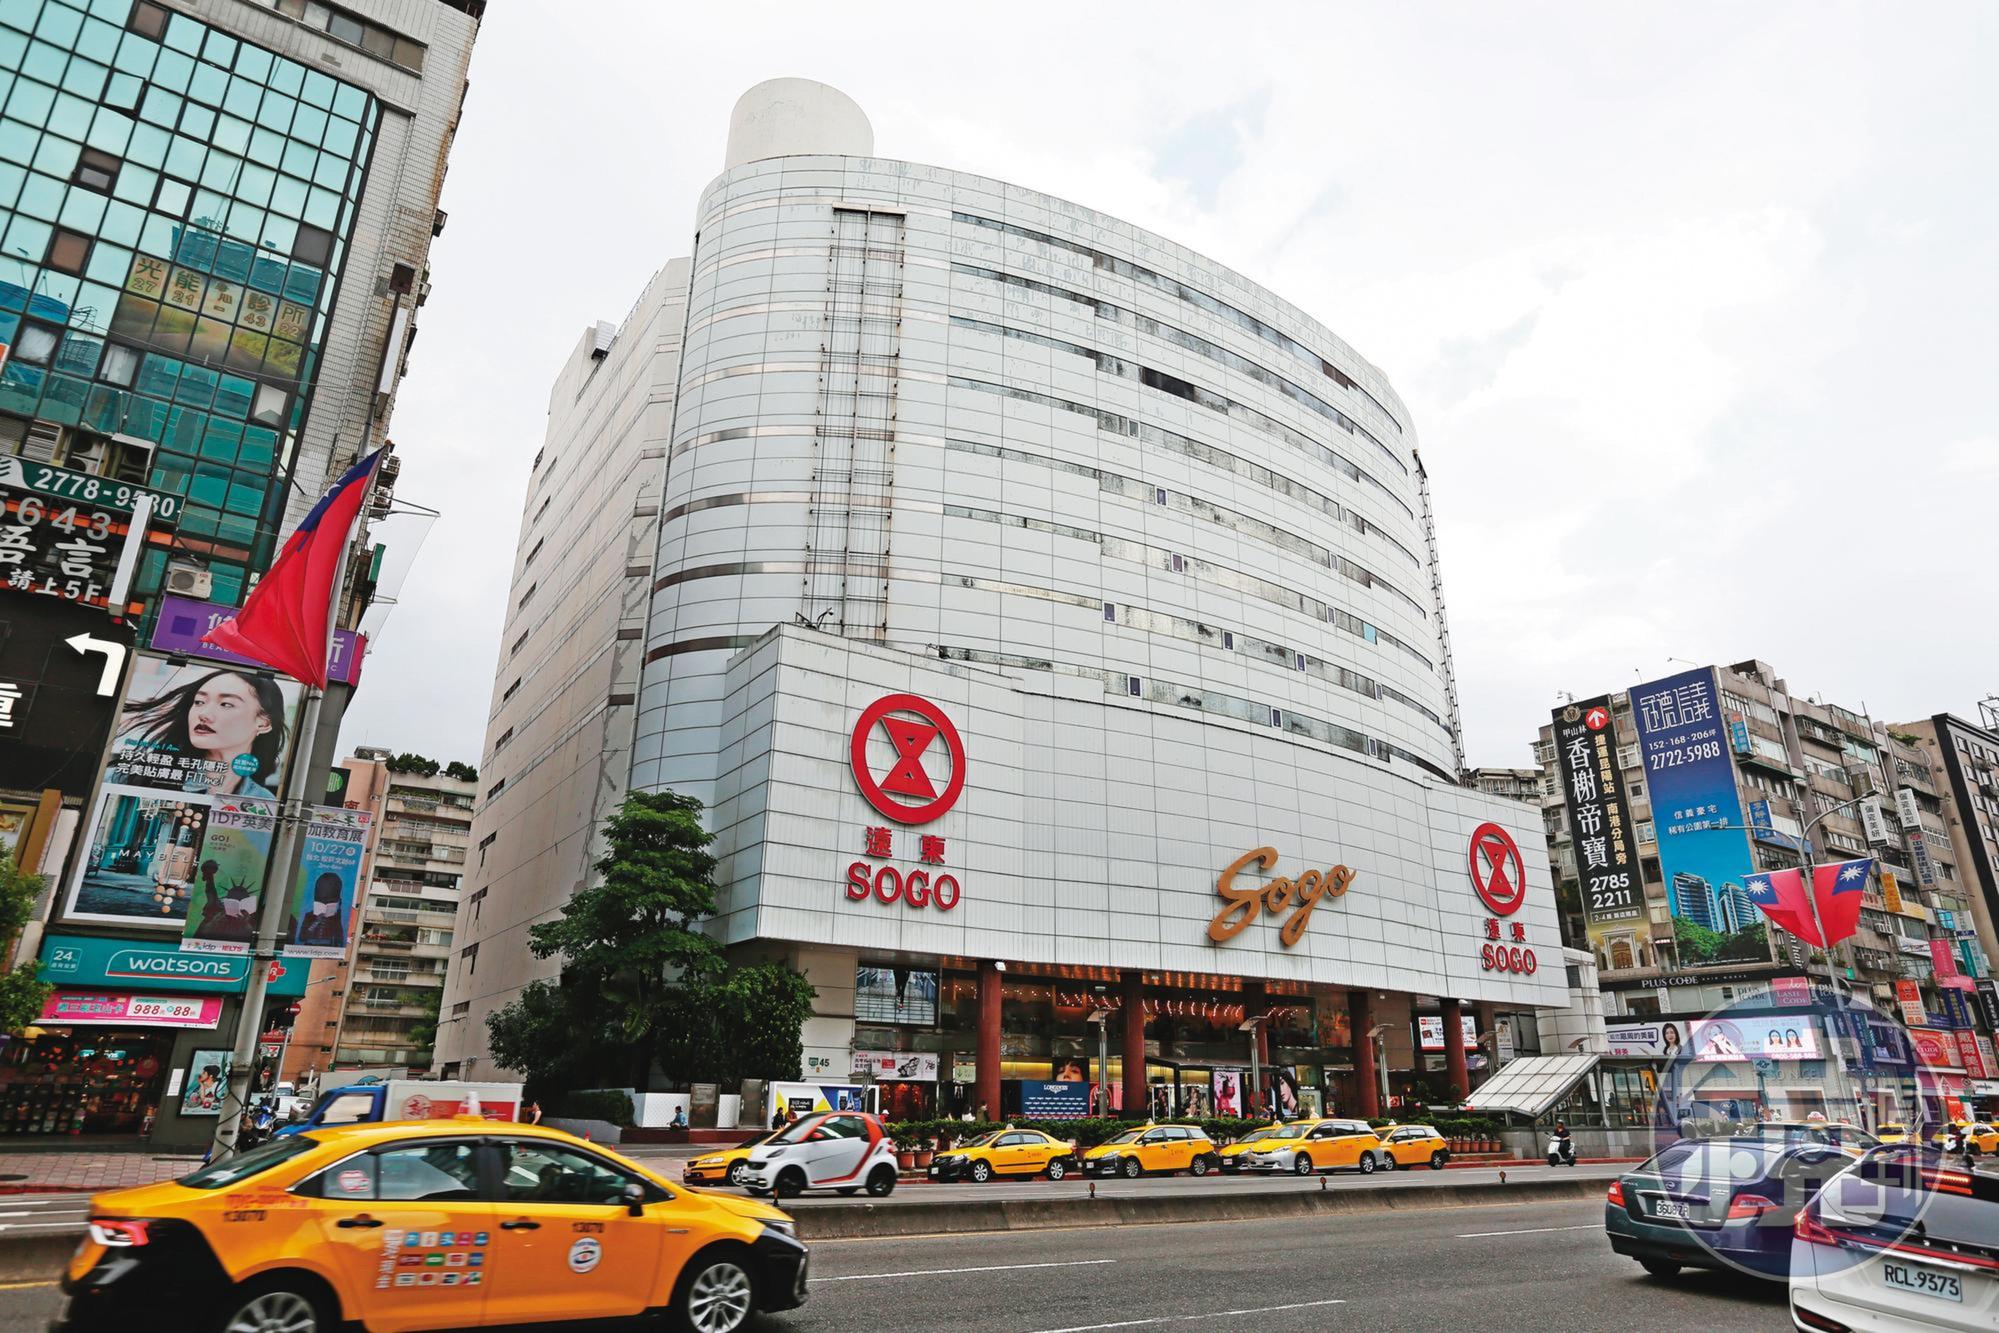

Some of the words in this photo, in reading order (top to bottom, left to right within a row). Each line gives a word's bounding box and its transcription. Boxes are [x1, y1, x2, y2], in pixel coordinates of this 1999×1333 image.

[7, 568, 103, 603] 請上5F
[120, 749, 174, 766] 持久輕盈
[177, 757, 229, 773] 毛孔隱形
[1650, 740, 1721, 771] 2722-5988
[1566, 736, 1609, 871] 香榭帝寶
[1673, 803, 1719, 821] 信義豪宅
[211, 834, 230, 843] GO!
[1605, 802, 1628, 866] 南港分局旁
[846, 861, 961, 911] SOGO
[1589, 872, 1630, 893] 2785
[1207, 846, 1357, 947] Sogo
[1592, 889, 1632, 909] 2211
[53, 950, 73, 961] 24
[129, 956, 231, 975] watsons
[1481, 943, 1538, 975] SOGO
[1641, 978, 1668, 989] PLUS
